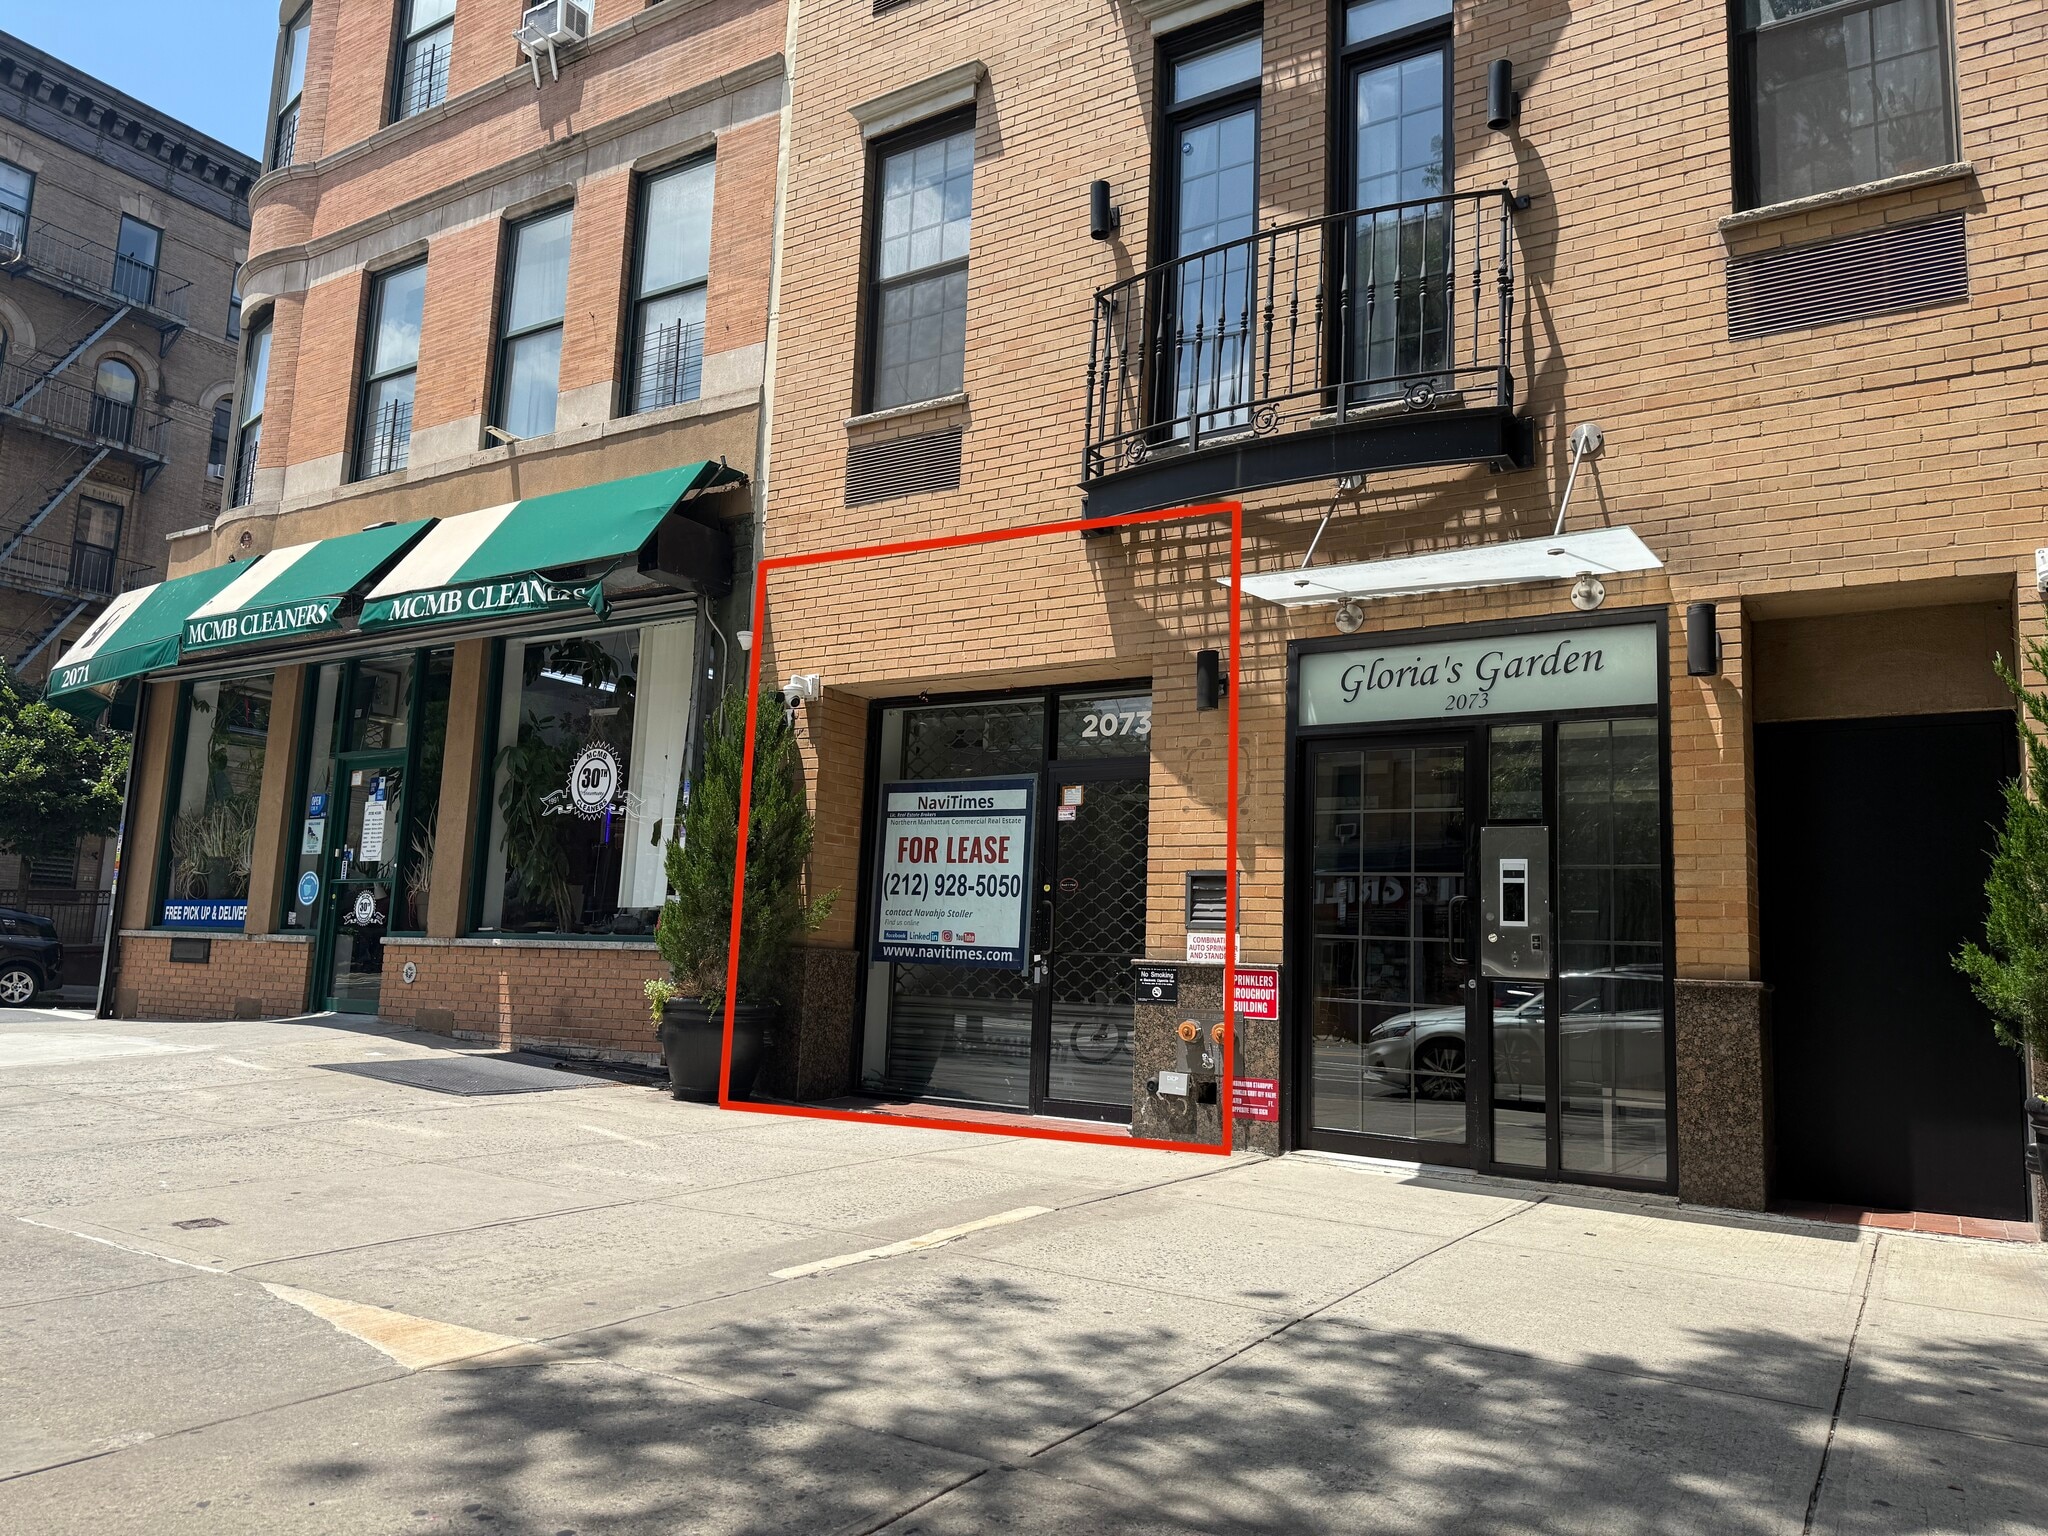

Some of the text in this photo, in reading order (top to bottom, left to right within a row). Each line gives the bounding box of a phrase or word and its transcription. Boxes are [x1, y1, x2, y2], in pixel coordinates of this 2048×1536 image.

[388, 589, 461, 621] MCMB
[187, 603, 329, 645] MCMB CLEANERS
[61, 664, 90, 688] 2071
[1340, 639, 1604, 703] Gloria's Garden
[1444, 692, 1489, 711] 2073
[1081, 711, 1152, 738] 2073
[586, 750, 608, 760] MCMB
[576, 799, 608, 812] CLEANERS
[917, 794, 994, 811] NaviTimes
[897, 836, 1011, 864] FOR LEASE
[883, 873, 1021, 901] (212) 928-5050
[164, 905, 248, 921] FREE PICK UP & DELIVE
[885, 908, 973, 920] contact Navahjo Stoller
[1192, 936, 1226, 944] COMBINATI
[1206, 944, 1239, 952] SPRINR
[883, 945, 1013, 962] www.navitimes.com
[1150, 971, 1174, 979] Smoking
[1234, 974, 1274, 987] PRINKLERS
[1234, 987, 1275, 1000] ROUGHOUT
[1234, 1000, 1268, 1014] BUILDING
